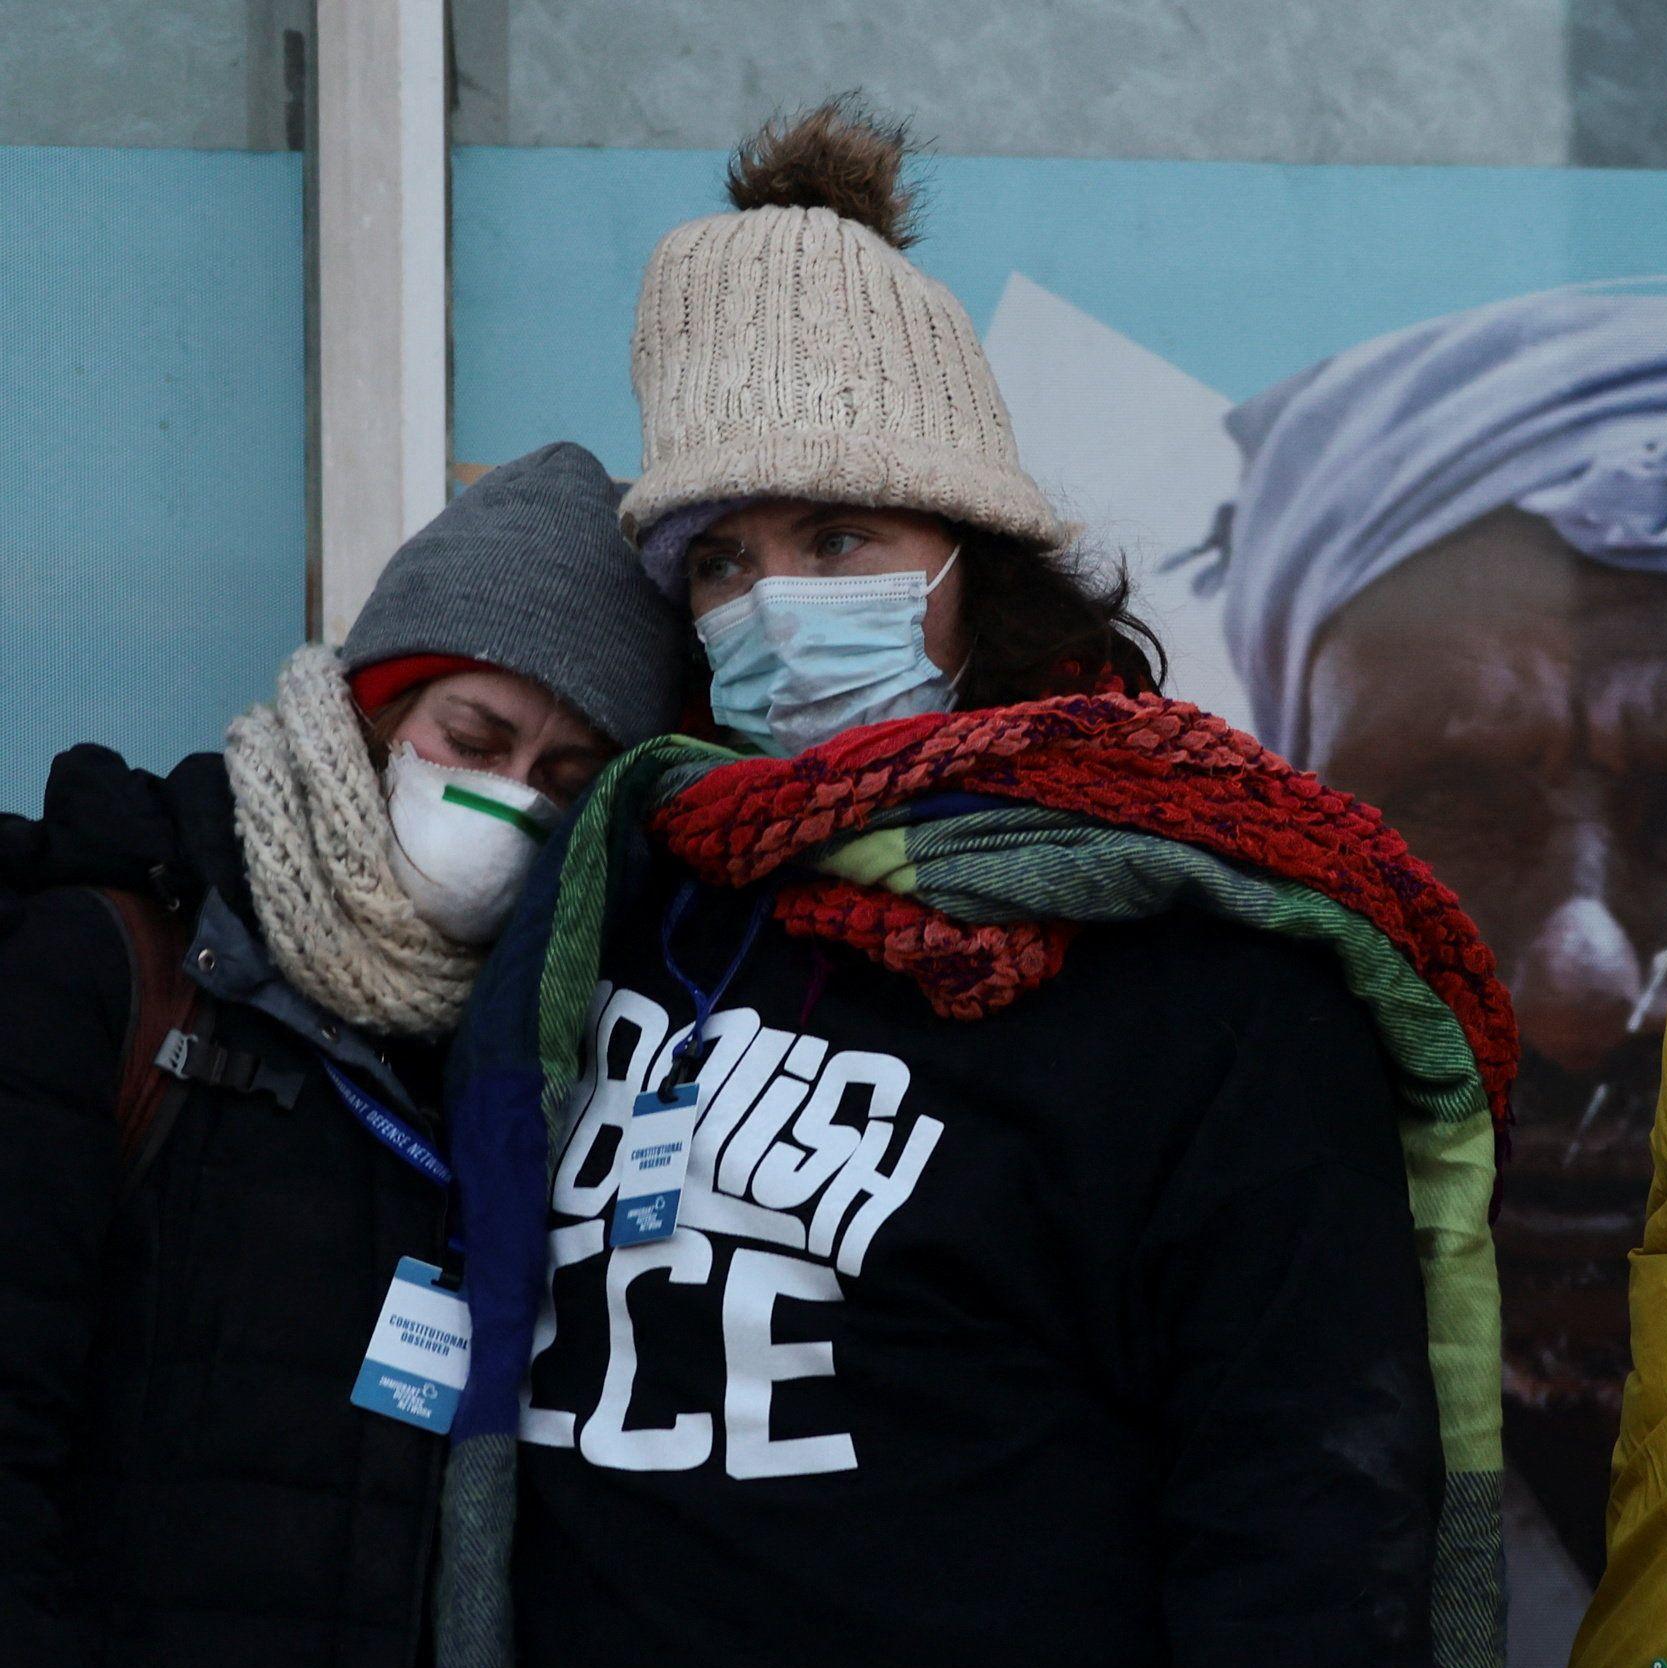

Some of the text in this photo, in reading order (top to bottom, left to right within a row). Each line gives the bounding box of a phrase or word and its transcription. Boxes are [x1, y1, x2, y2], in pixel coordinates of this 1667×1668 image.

[324, 1062, 369, 1114] IGRANT
[366, 1109, 411, 1148] DEFENSE
[388, 1313, 468, 1351] CONSTITUTIONAL
[400, 1330, 451, 1357] OBSERVER
